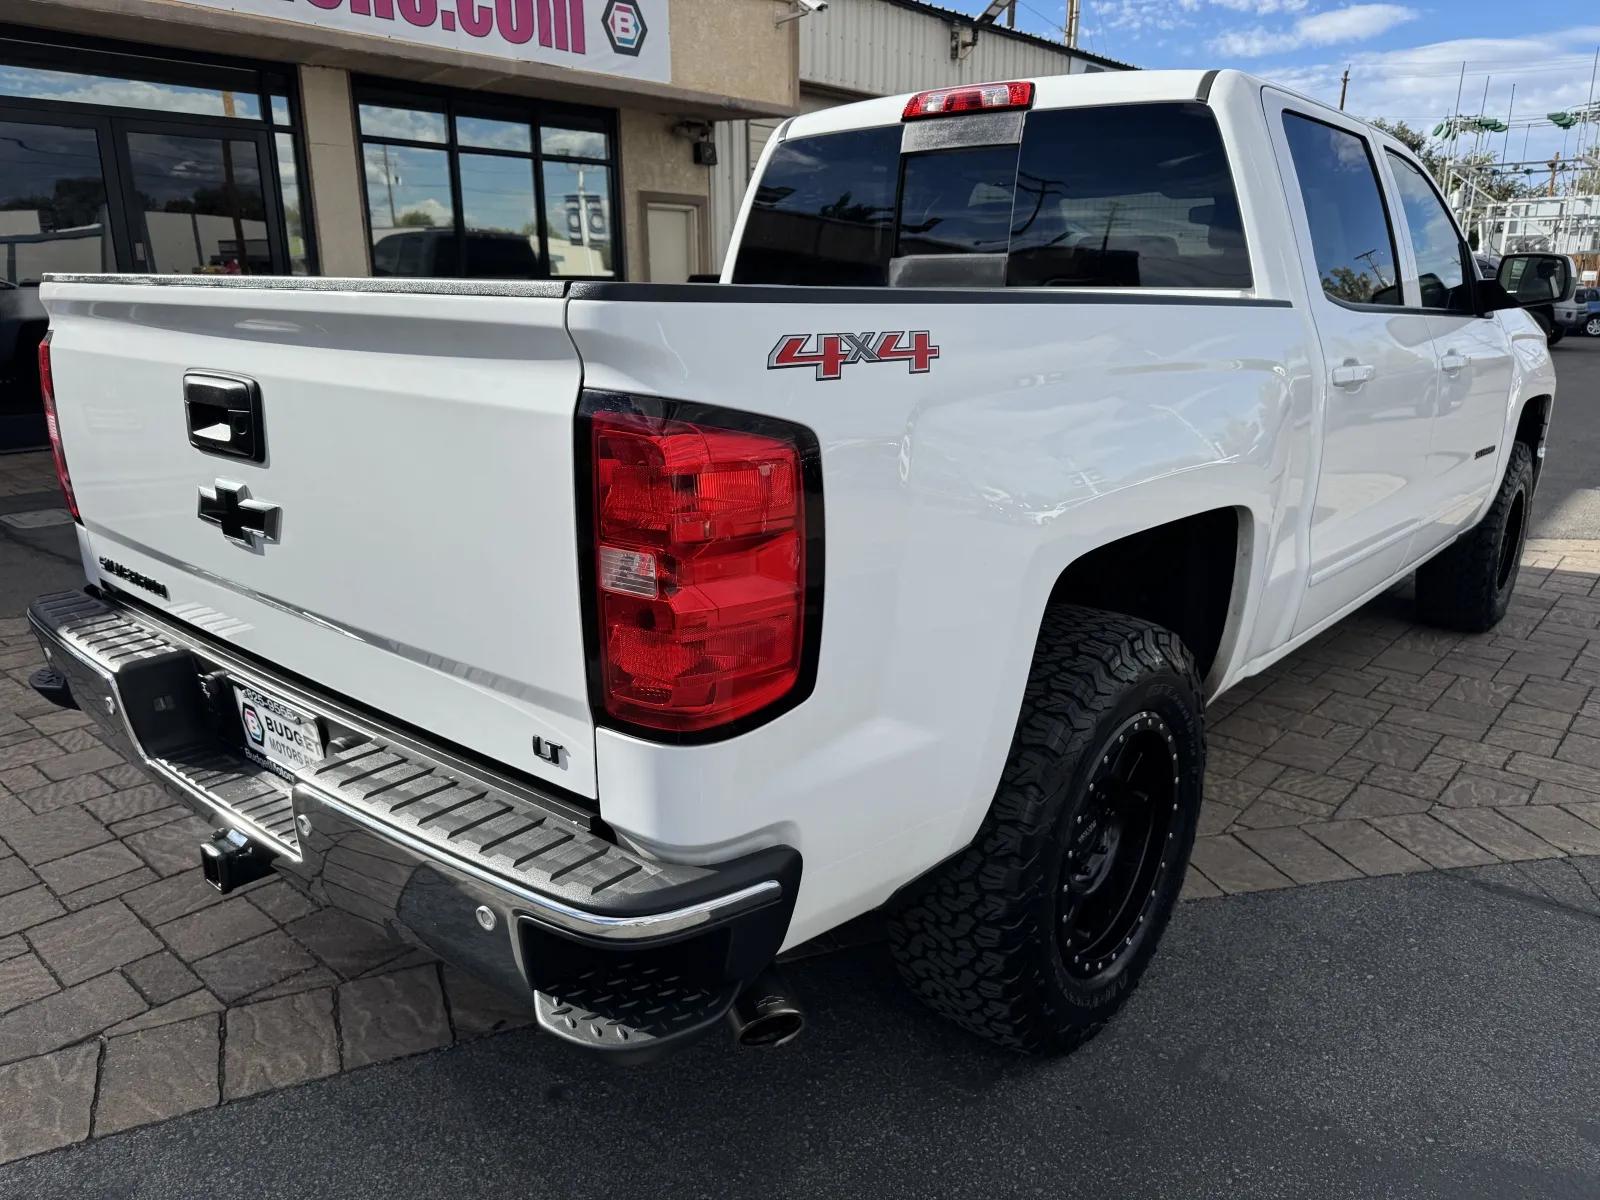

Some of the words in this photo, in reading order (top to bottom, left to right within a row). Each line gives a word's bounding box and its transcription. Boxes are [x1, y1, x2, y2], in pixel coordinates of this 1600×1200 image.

[265, 716, 321, 757] BUDGET
[532, 735, 564, 764] LT
[269, 738, 304, 765] MOTORS
